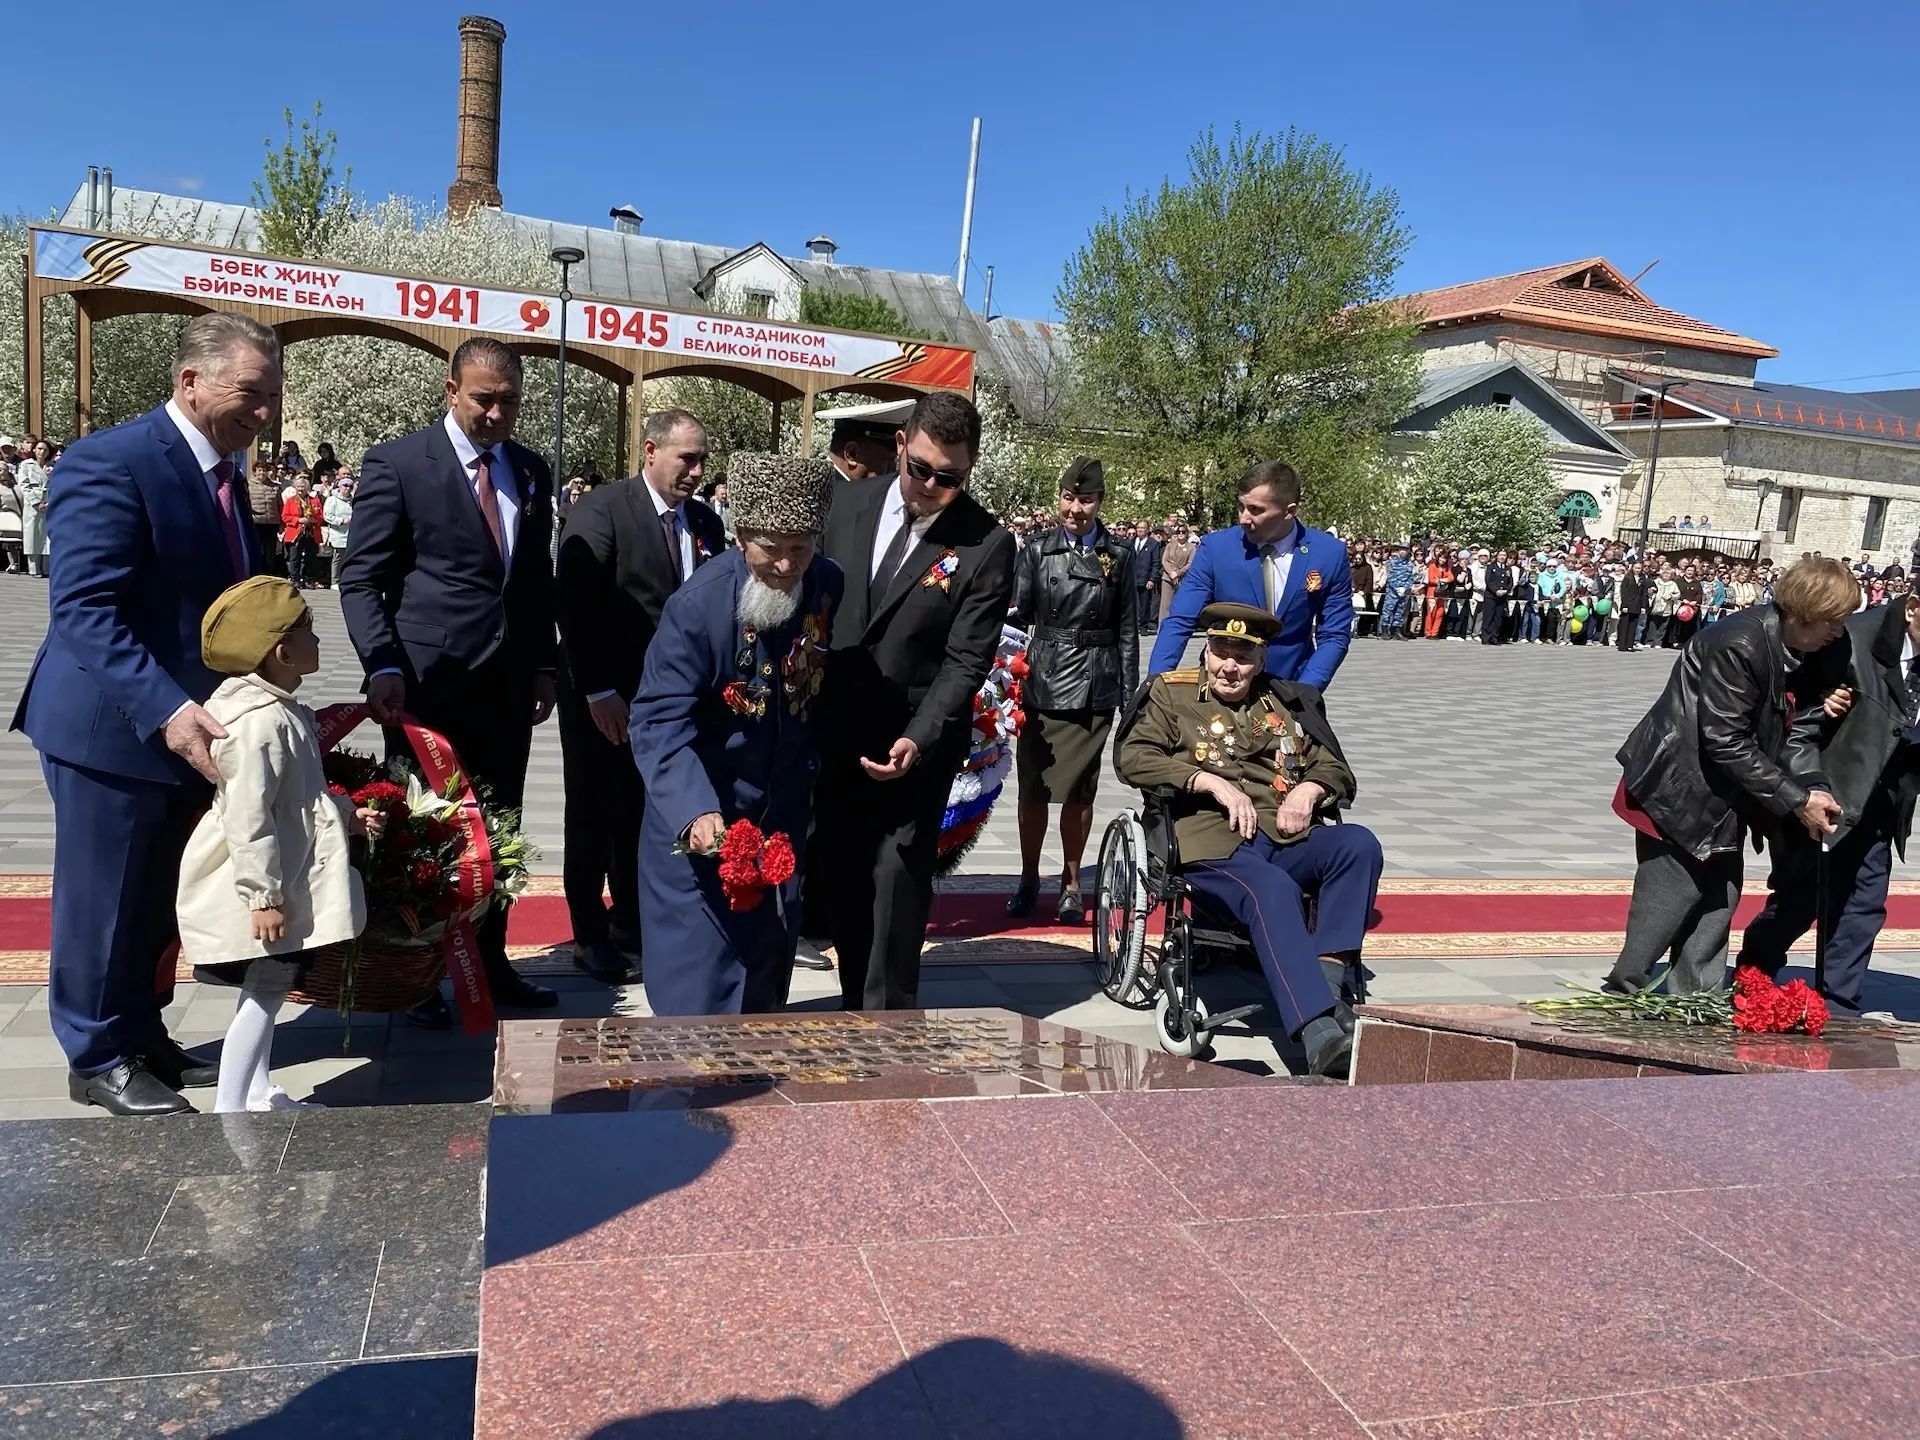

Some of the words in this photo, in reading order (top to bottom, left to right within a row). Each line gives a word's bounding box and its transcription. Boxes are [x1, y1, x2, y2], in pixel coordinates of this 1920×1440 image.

[210, 258, 268, 279] БӨЕК
[184, 275, 288, 301] БӘЙРӘМЕ
[294, 290, 364, 311] БЕЛӘН
[396, 281, 480, 325] 1941
[583, 305, 669, 348] 1945
[696, 321, 707, 332] С
[712, 322, 826, 348] ПРАЗДНИКОМ
[683, 337, 762, 358] ВЕЛИКОЙ
[766, 348, 836, 368] ПОБЕДЫ
[1564, 507, 1591, 517] ХЛЕБ
[454, 948, 481, 1005] района
